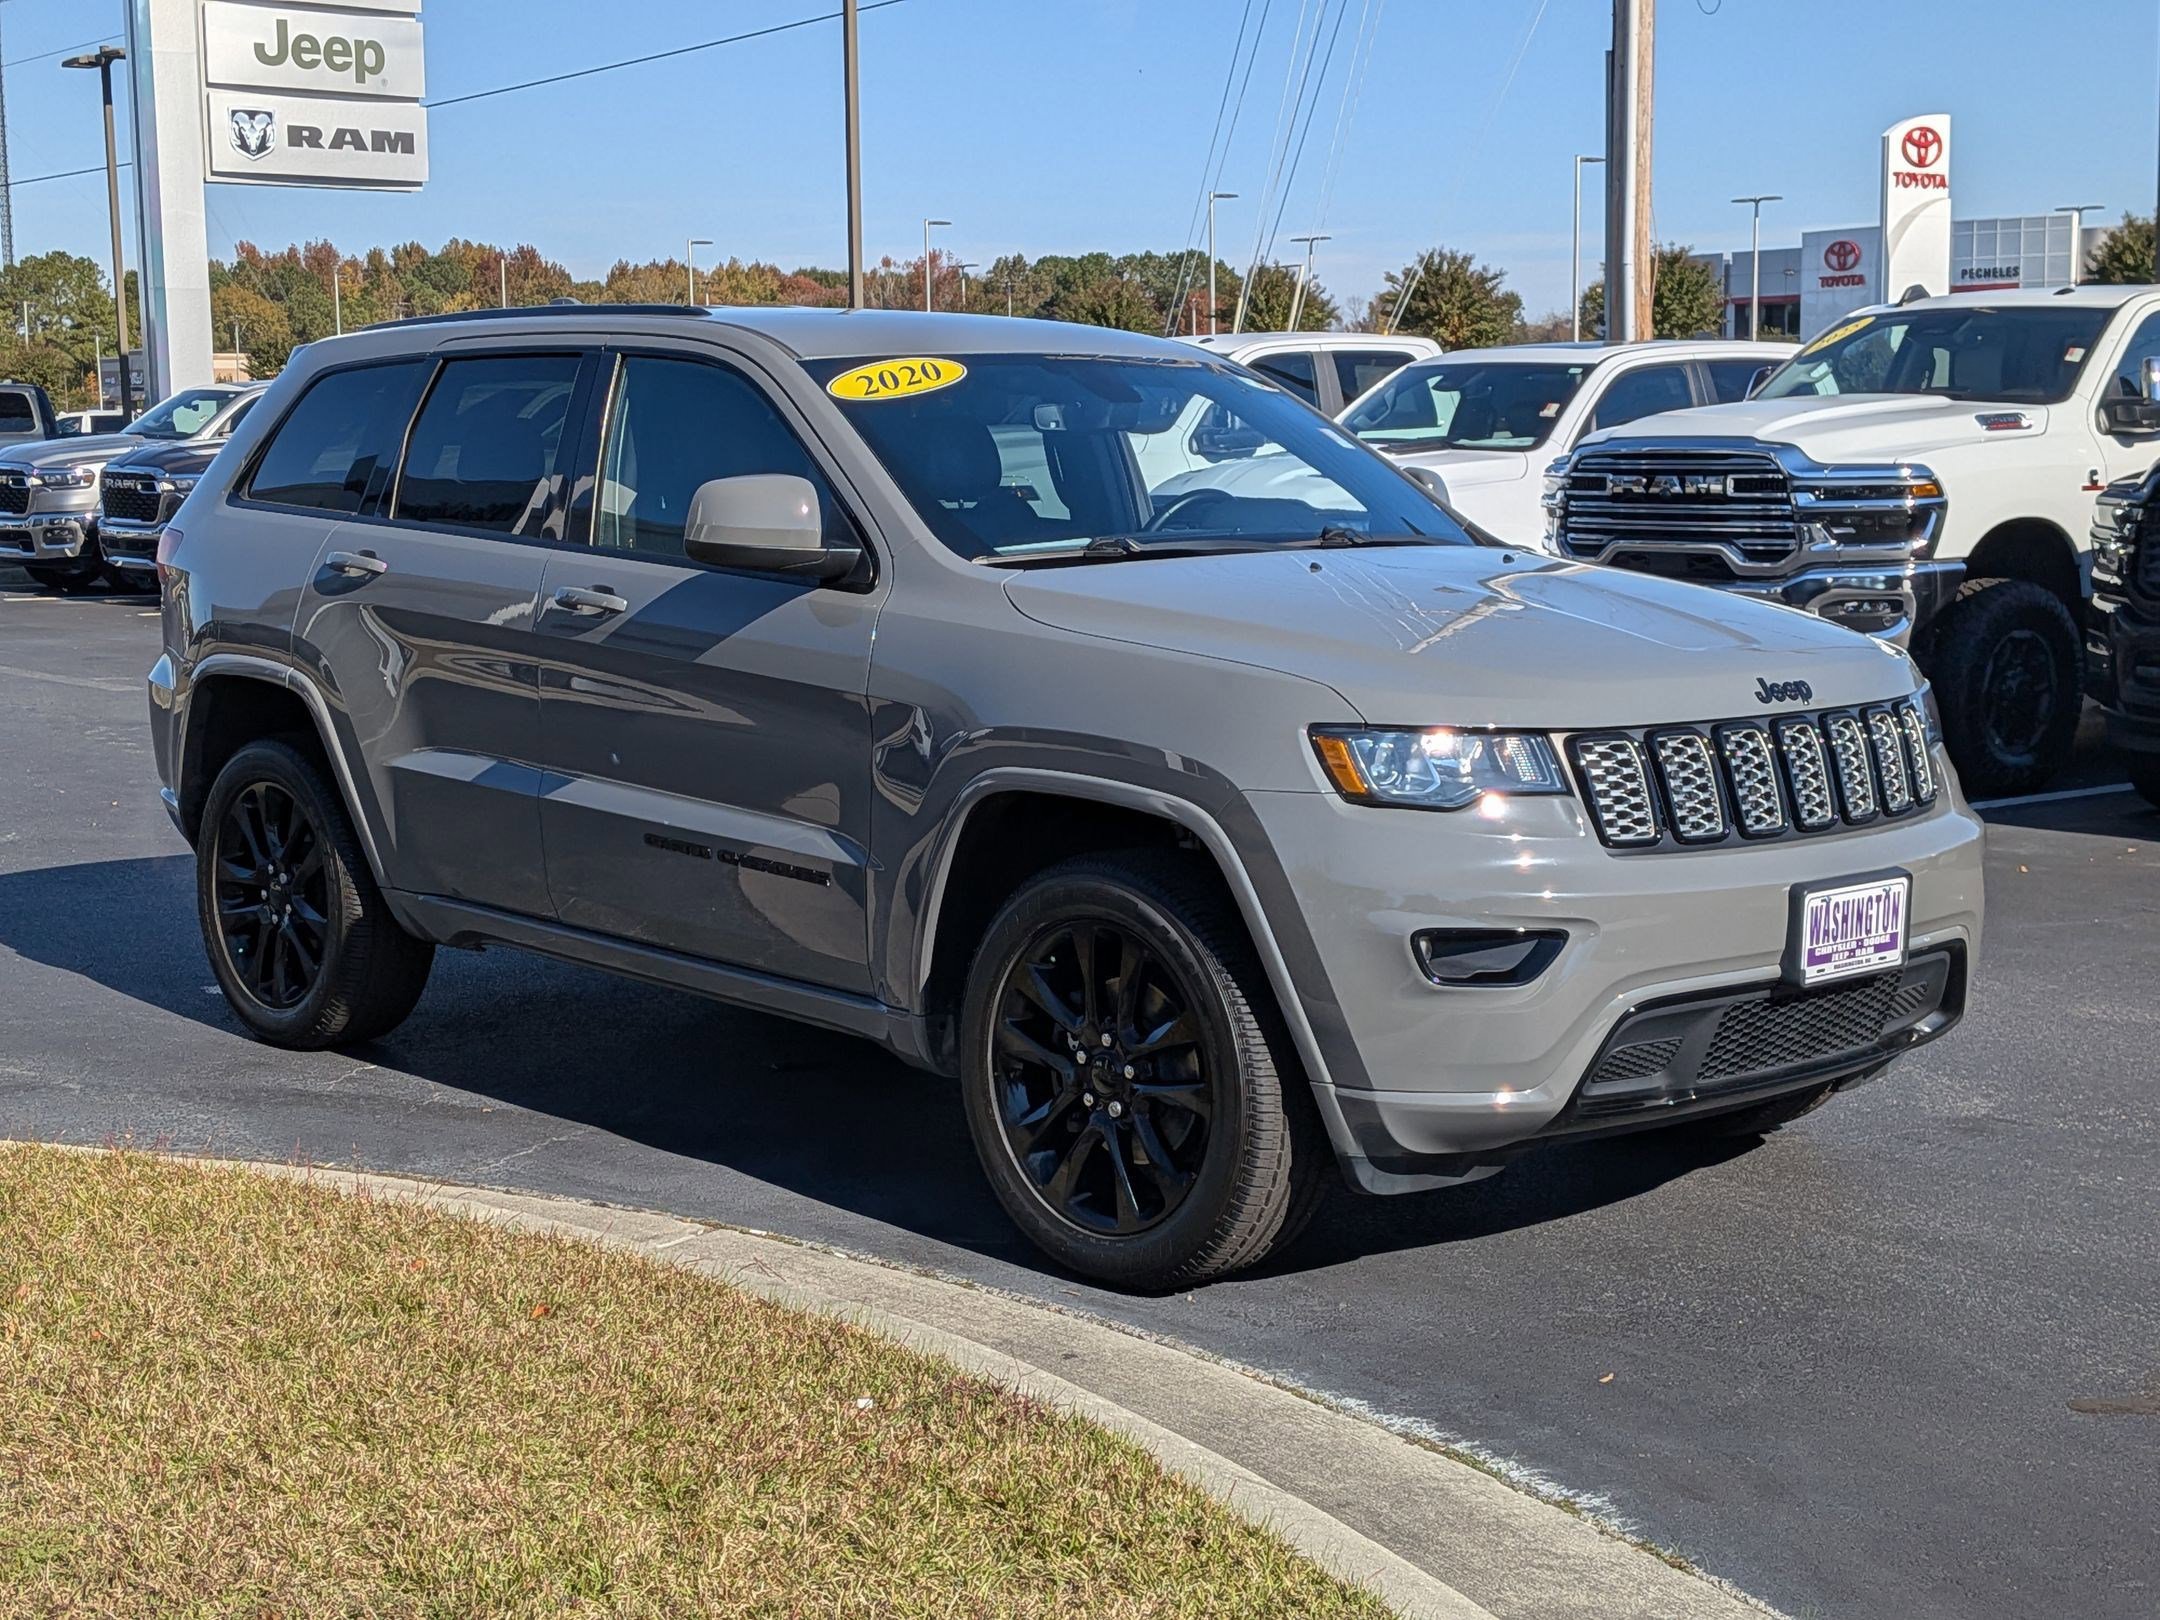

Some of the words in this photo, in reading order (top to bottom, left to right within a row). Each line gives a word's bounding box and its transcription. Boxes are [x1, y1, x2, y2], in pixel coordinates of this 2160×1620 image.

[253, 19, 386, 84] Jeep
[287, 124, 415, 155] RAM
[1893, 171, 1947, 189] TOYOTA
[1818, 274, 1866, 288] TOYOTA
[1961, 265, 2020, 280] PECHELES
[855, 361, 942, 396] 2020
[1611, 474, 1725, 495] RAM
[1754, 677, 1813, 705] Jeep
[1810, 890, 1900, 946] WASHINGTON
[1863, 934, 1891, 948] DODGE
